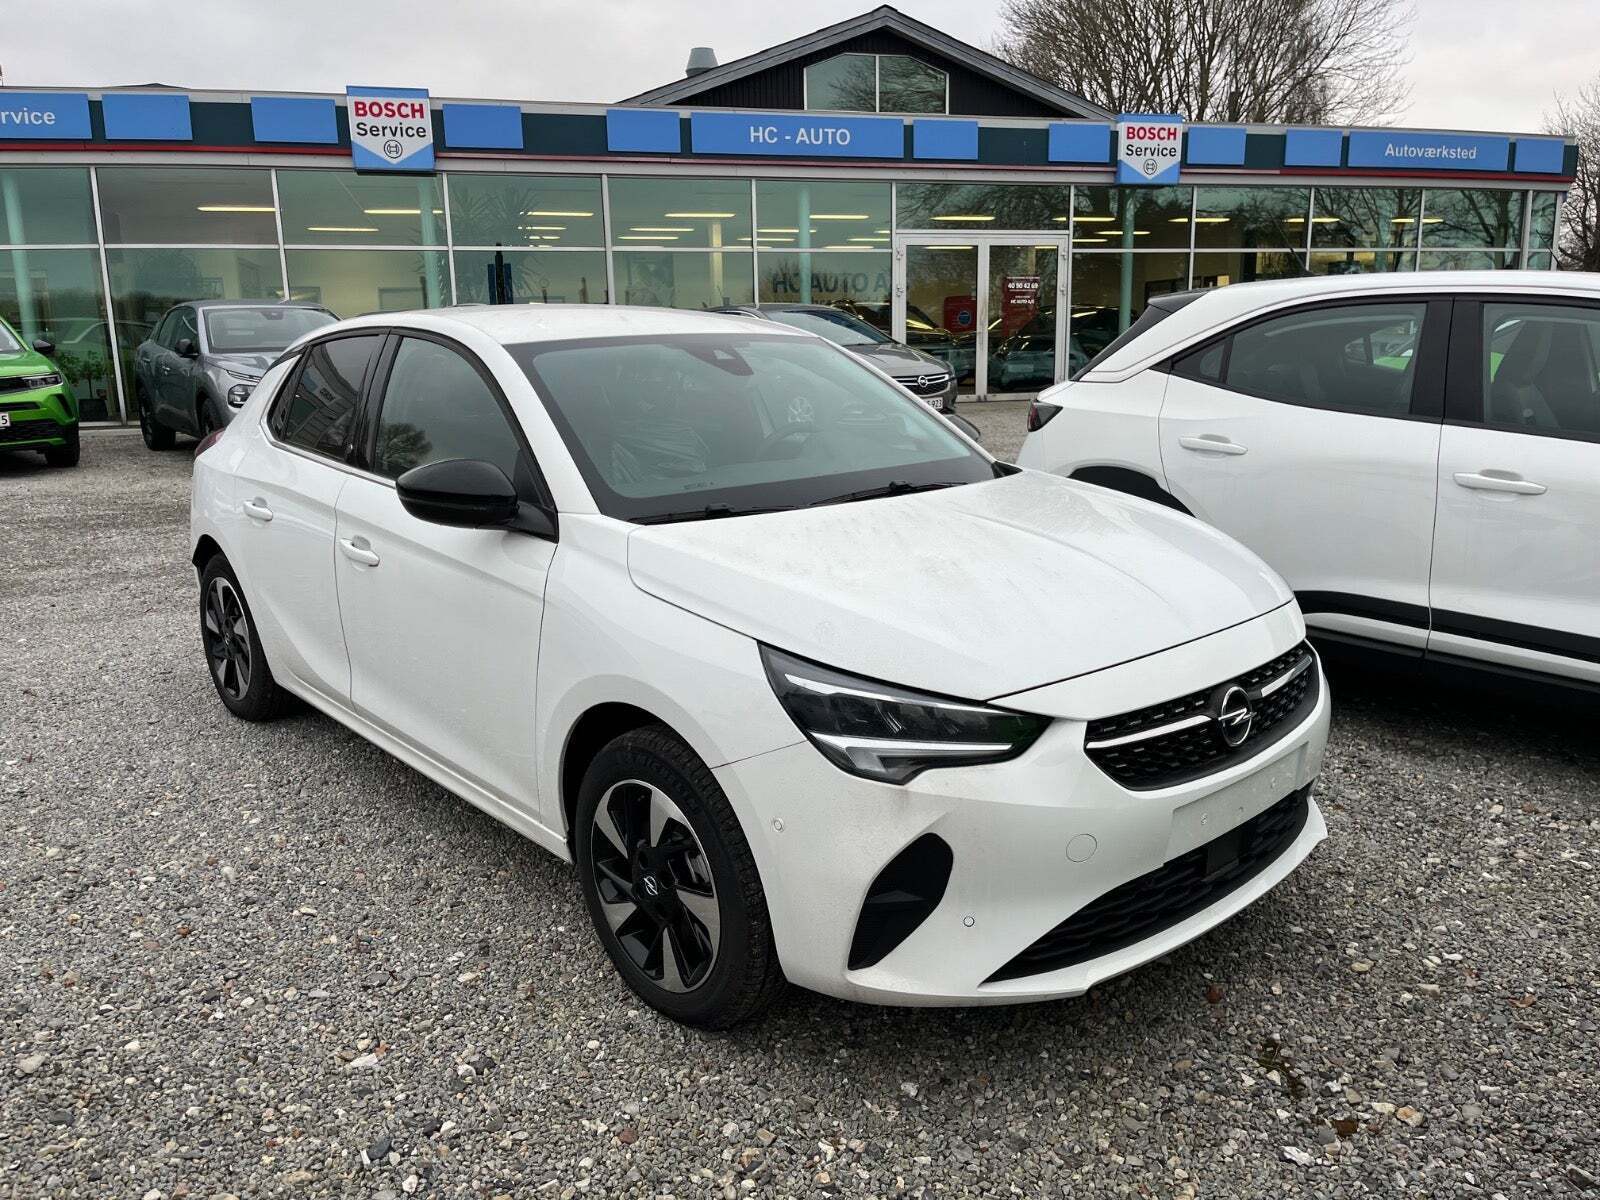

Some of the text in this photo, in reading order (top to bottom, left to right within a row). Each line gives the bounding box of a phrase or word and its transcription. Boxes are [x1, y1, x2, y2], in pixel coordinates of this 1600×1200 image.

[1, 107, 56, 125] rvice
[354, 100, 425, 119] BOSCH
[356, 120, 427, 139] Service
[750, 126, 778, 143] HC
[795, 127, 851, 146] AUTO
[1126, 126, 1178, 142] BOSCH
[1125, 143, 1178, 159] Service
[1384, 143, 1477, 161] Autoværksted
[810, 273, 868, 293] AUTO
